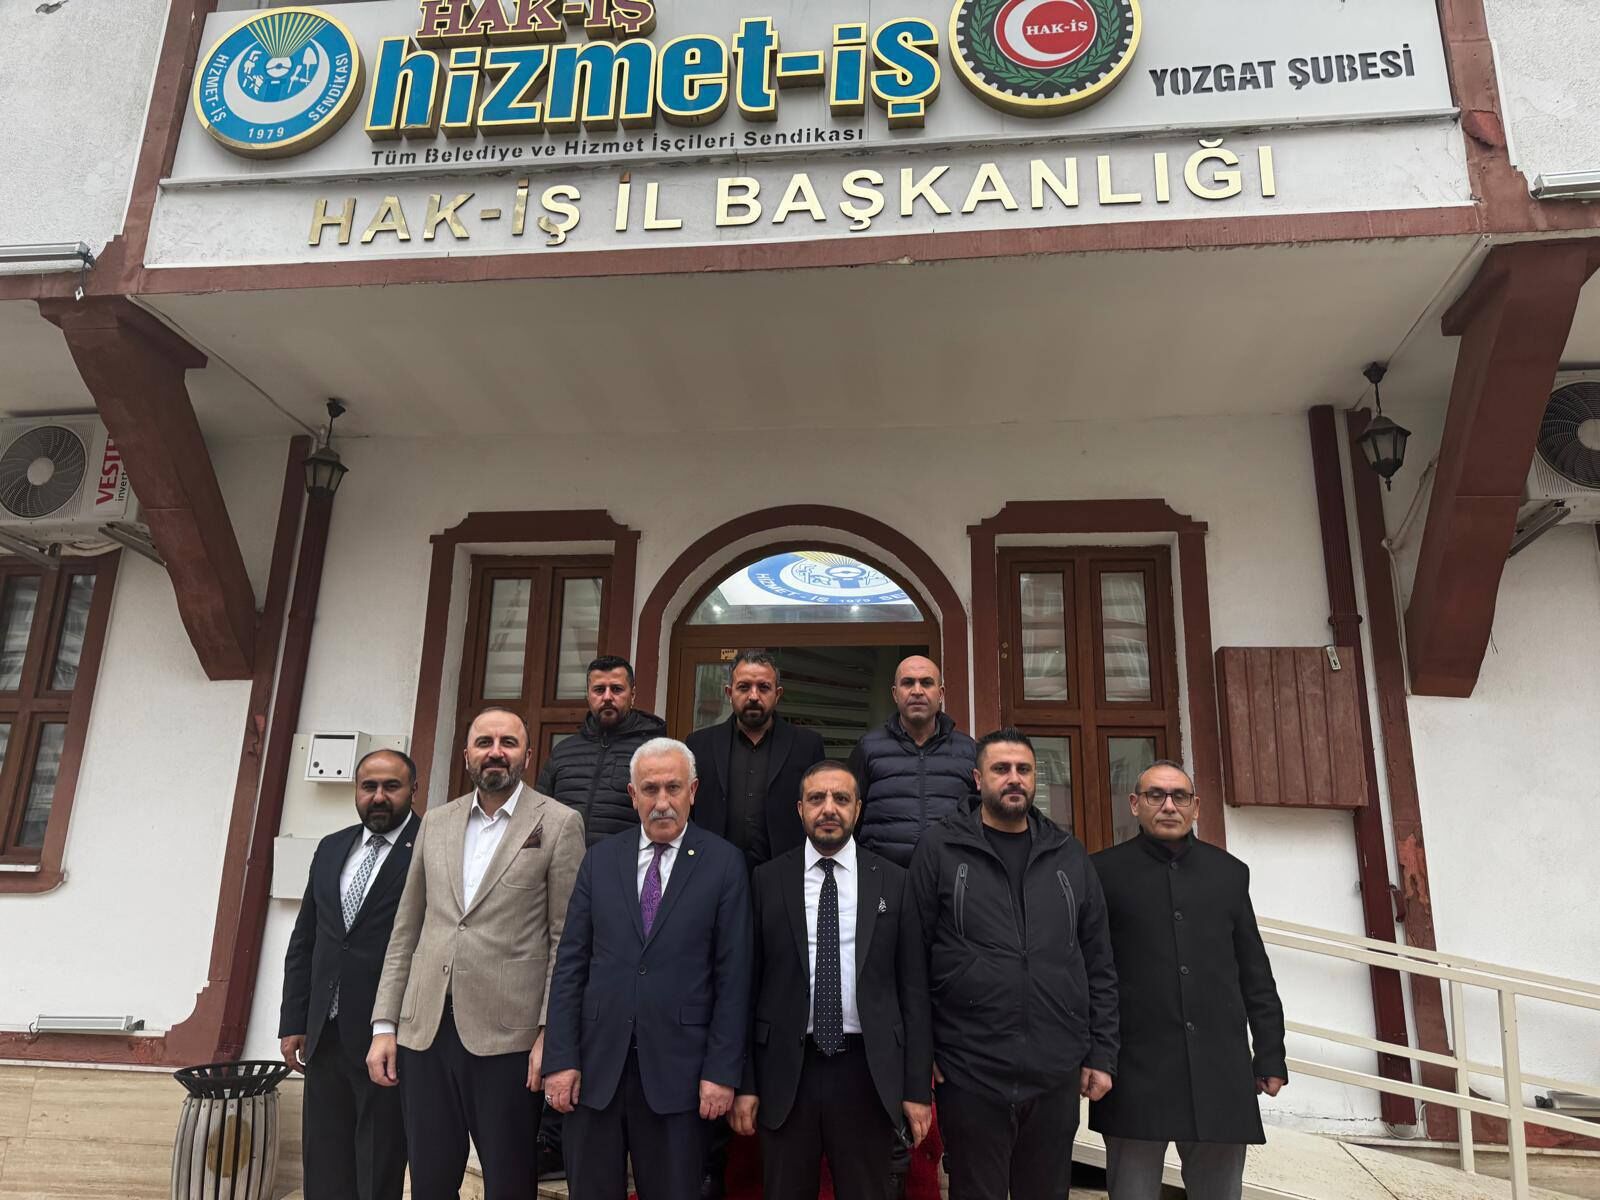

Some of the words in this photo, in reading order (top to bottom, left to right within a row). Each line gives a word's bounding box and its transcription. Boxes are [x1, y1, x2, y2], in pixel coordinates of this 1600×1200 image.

[308, 52, 348, 121] SENDİKASI
[364, 16, 941, 132] hizmet-iş
[1148, 60, 1277, 97] YOZGAT
[1287, 43, 1415, 91] ŞUBESİ
[248, 127, 284, 140] 1979
[372, 149, 417, 166] Tüm
[425, 145, 523, 164] Belediye
[531, 143, 556, 156] ve
[564, 137, 644, 156] Hizmet
[652, 132, 735, 151] İşçileri
[743, 127, 863, 146] Sendikası
[308, 177, 582, 246] HAK-İŞ
[615, 171, 683, 232] İL
[715, 138, 1276, 232] BAŞKANLIĞI
